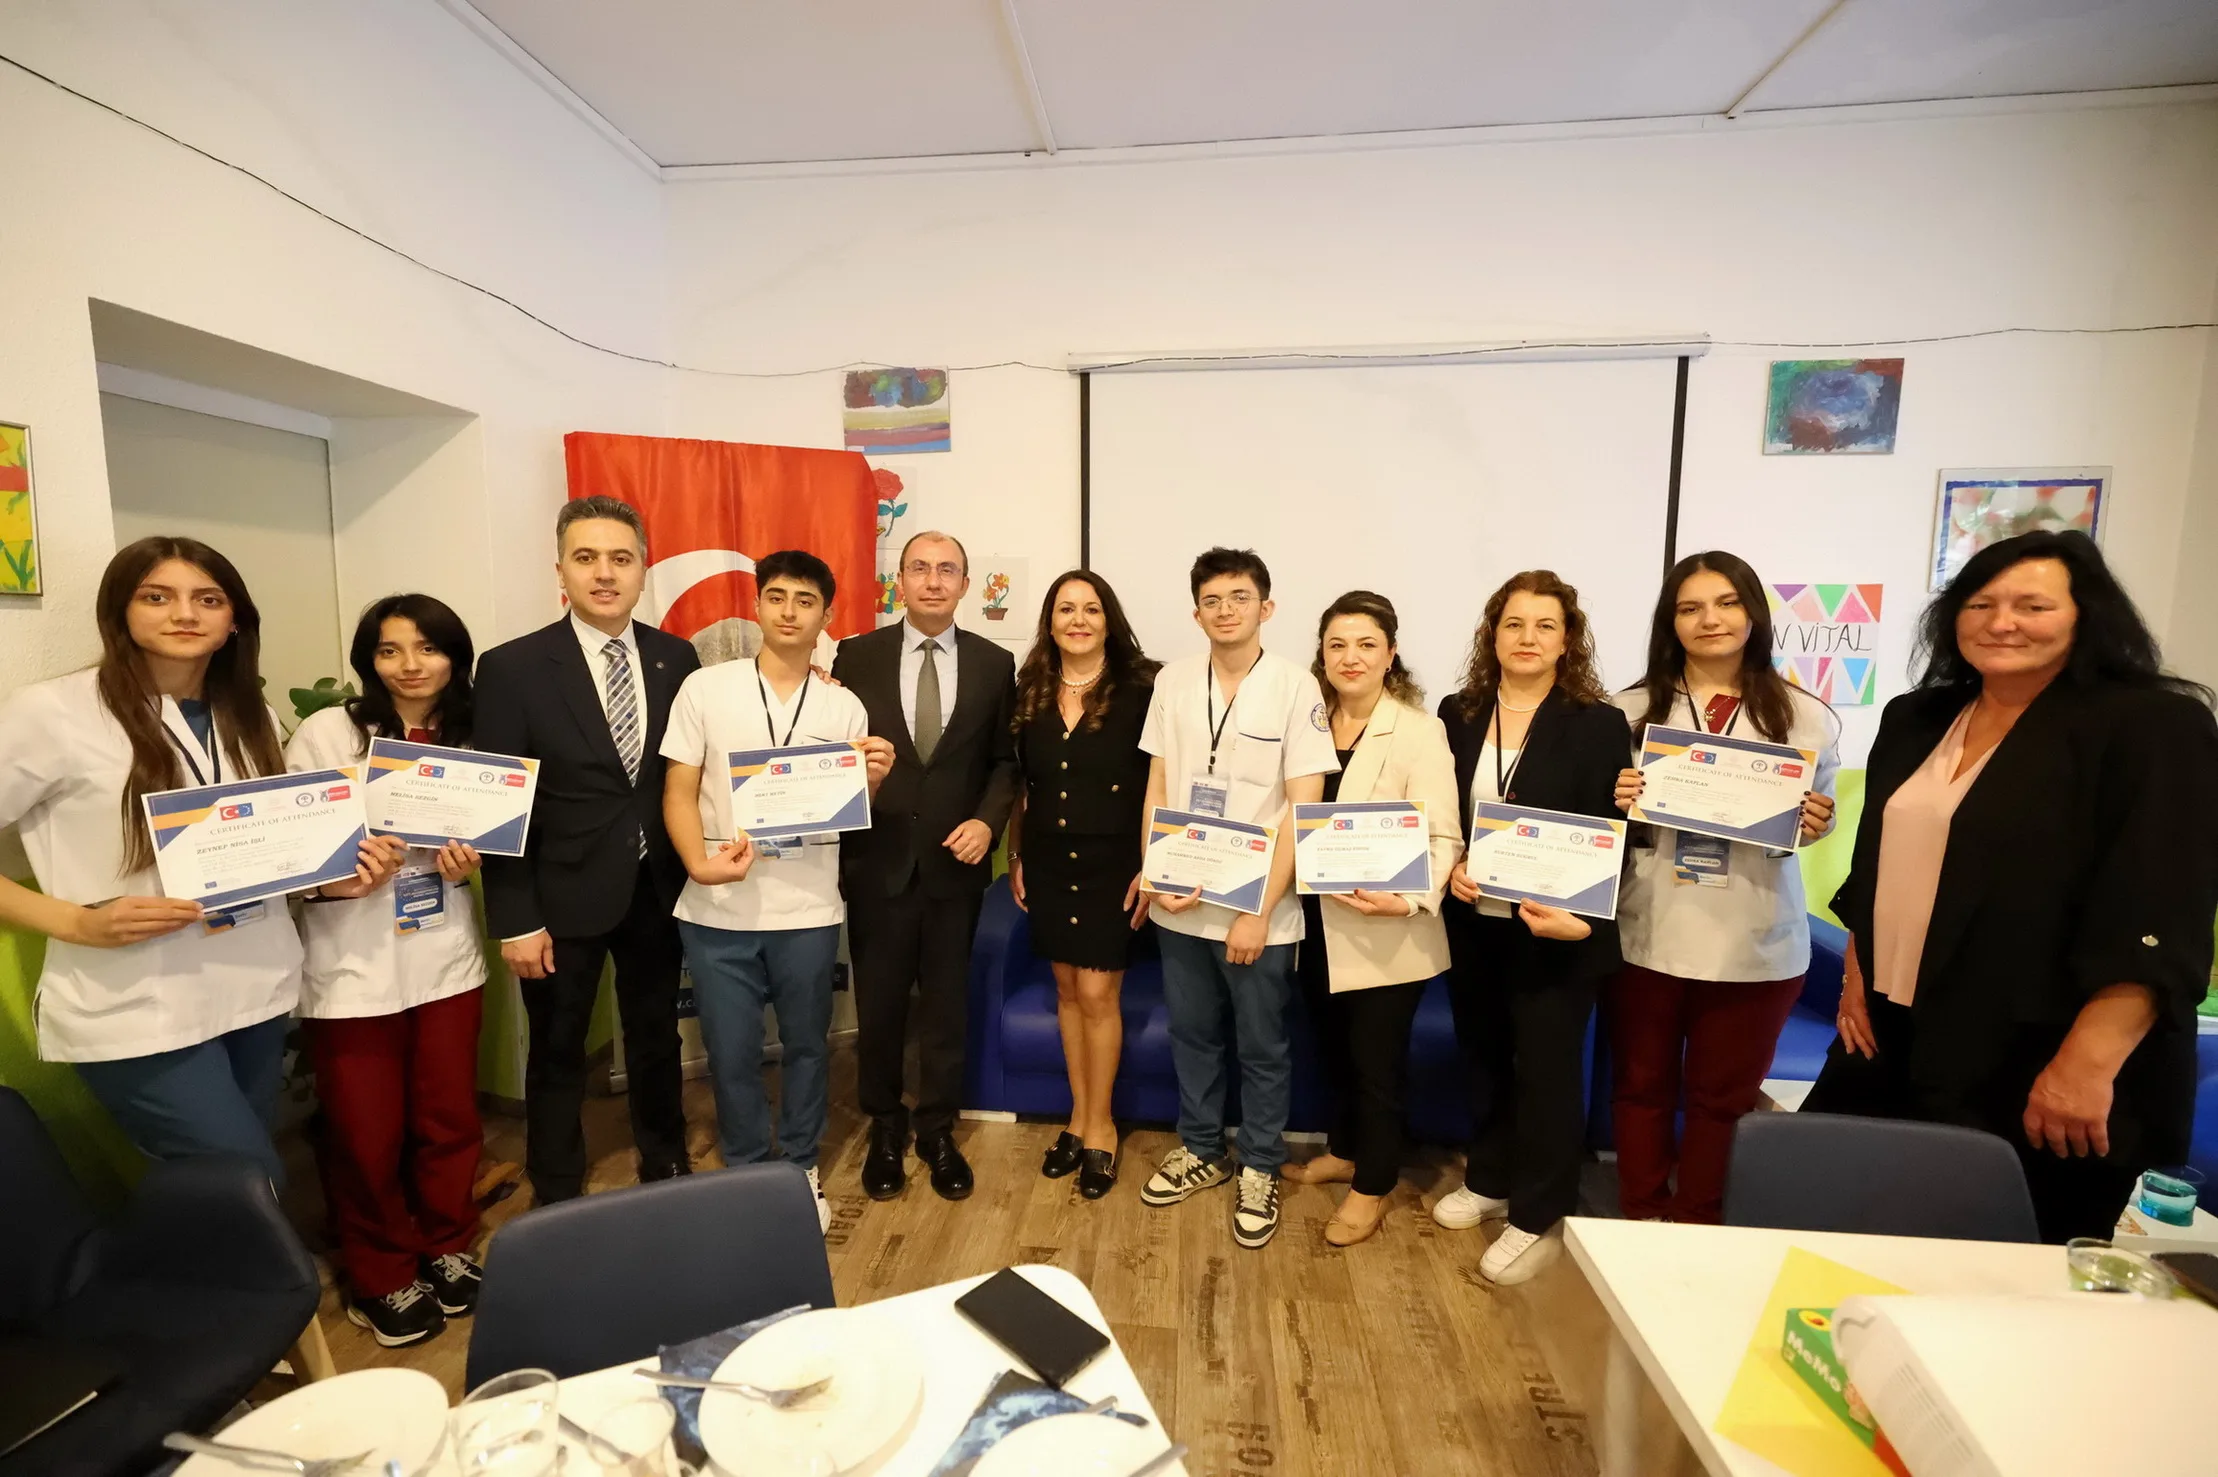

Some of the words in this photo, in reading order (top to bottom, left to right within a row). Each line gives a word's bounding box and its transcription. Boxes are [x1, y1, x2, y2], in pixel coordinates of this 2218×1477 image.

[1678, 764, 1721, 776] CERTIFICATE
[1735, 773, 1783, 787] ATTENDANCE
[405, 779, 450, 790] CERTIFICATE
[463, 786, 508, 797] ATTENDANCE
[210, 821, 265, 836] CERTIFICATE
[268, 817, 281, 825] OF
[282, 808, 336, 823] ATTENDANCE
